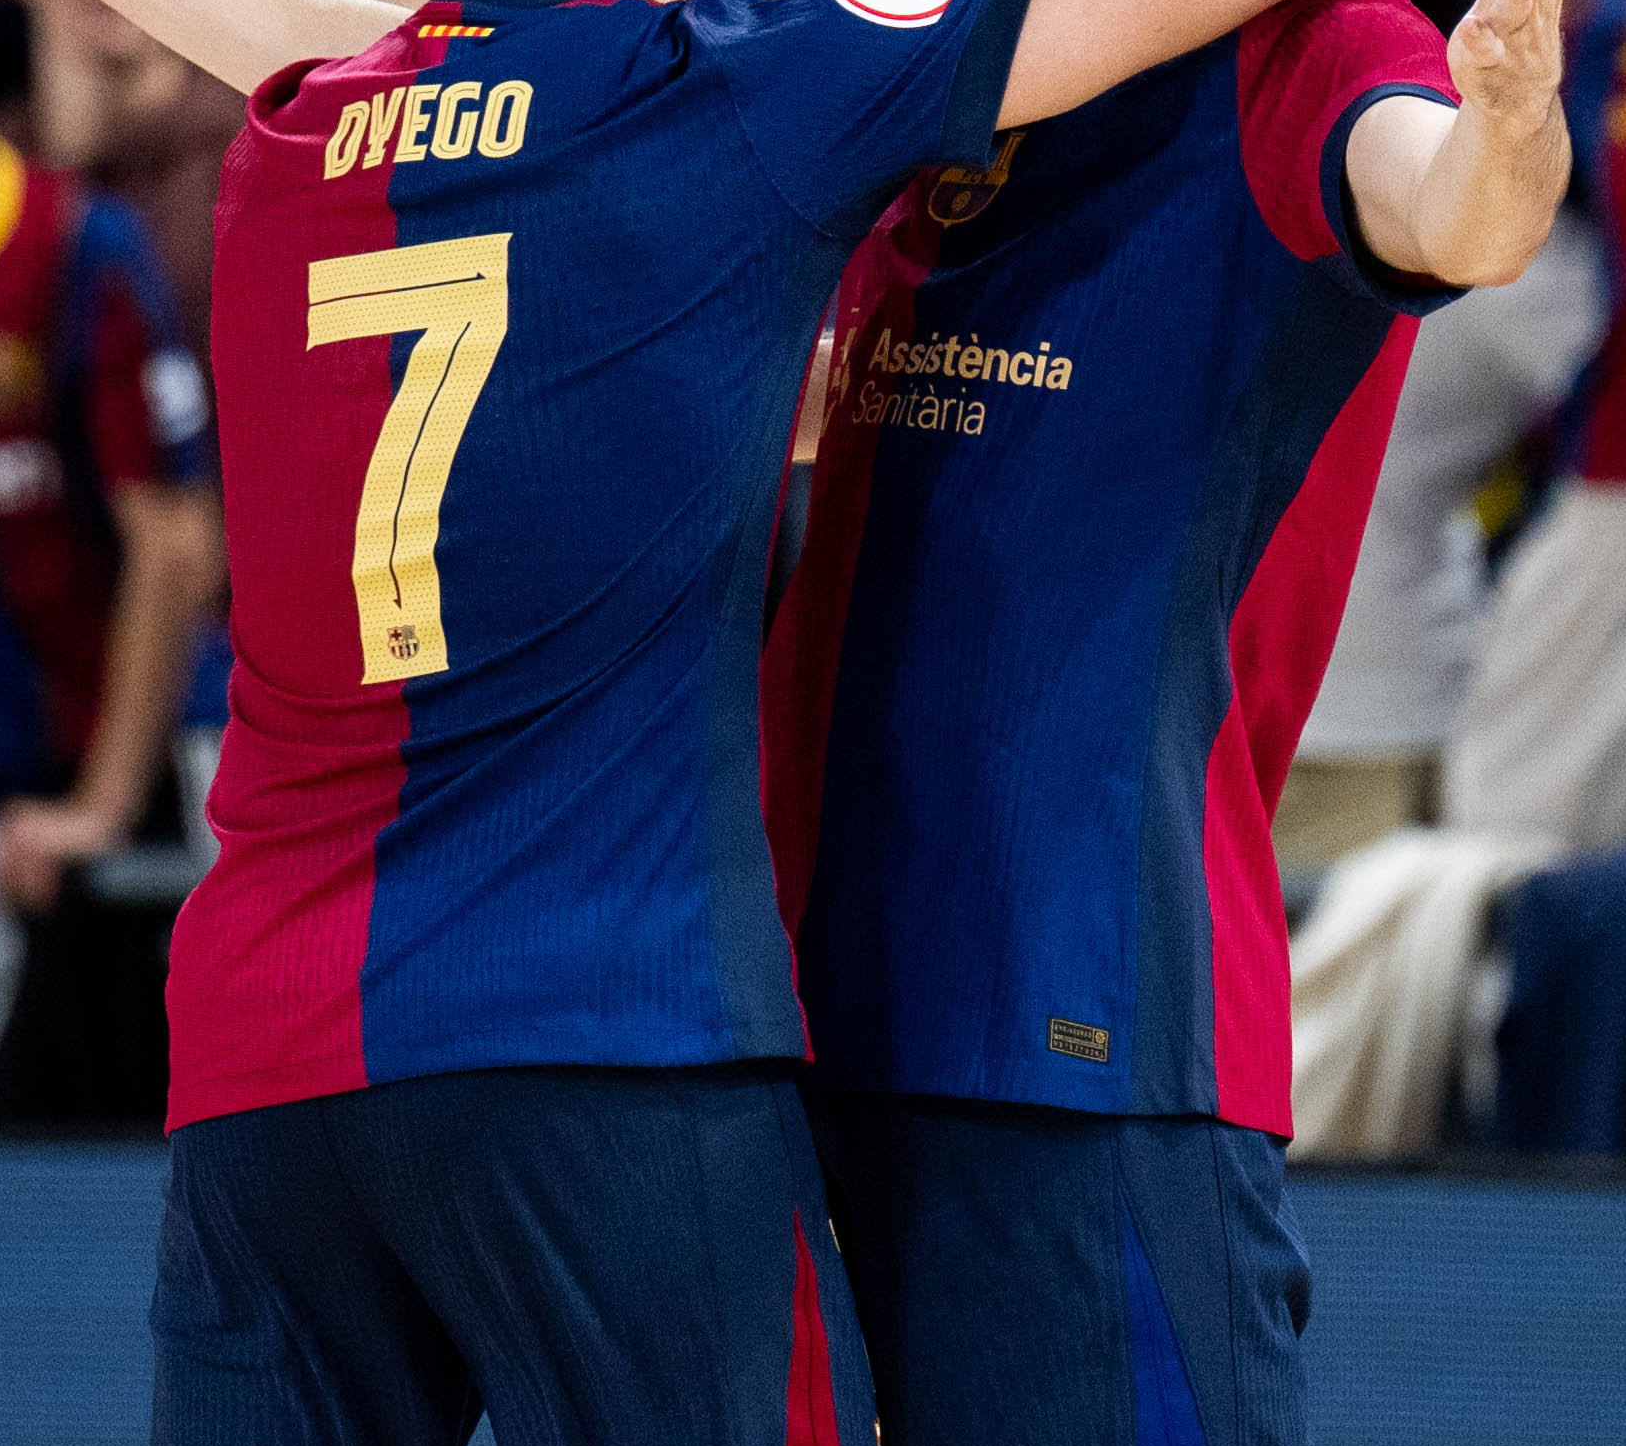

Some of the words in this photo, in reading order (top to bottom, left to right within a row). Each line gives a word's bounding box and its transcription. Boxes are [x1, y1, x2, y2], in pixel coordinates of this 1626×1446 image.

[323, 80, 534, 180] DYEGO
[868, 328, 1073, 390] Assistència
[852, 380, 986, 435] Sanitària
[307, 232, 514, 685] 7
